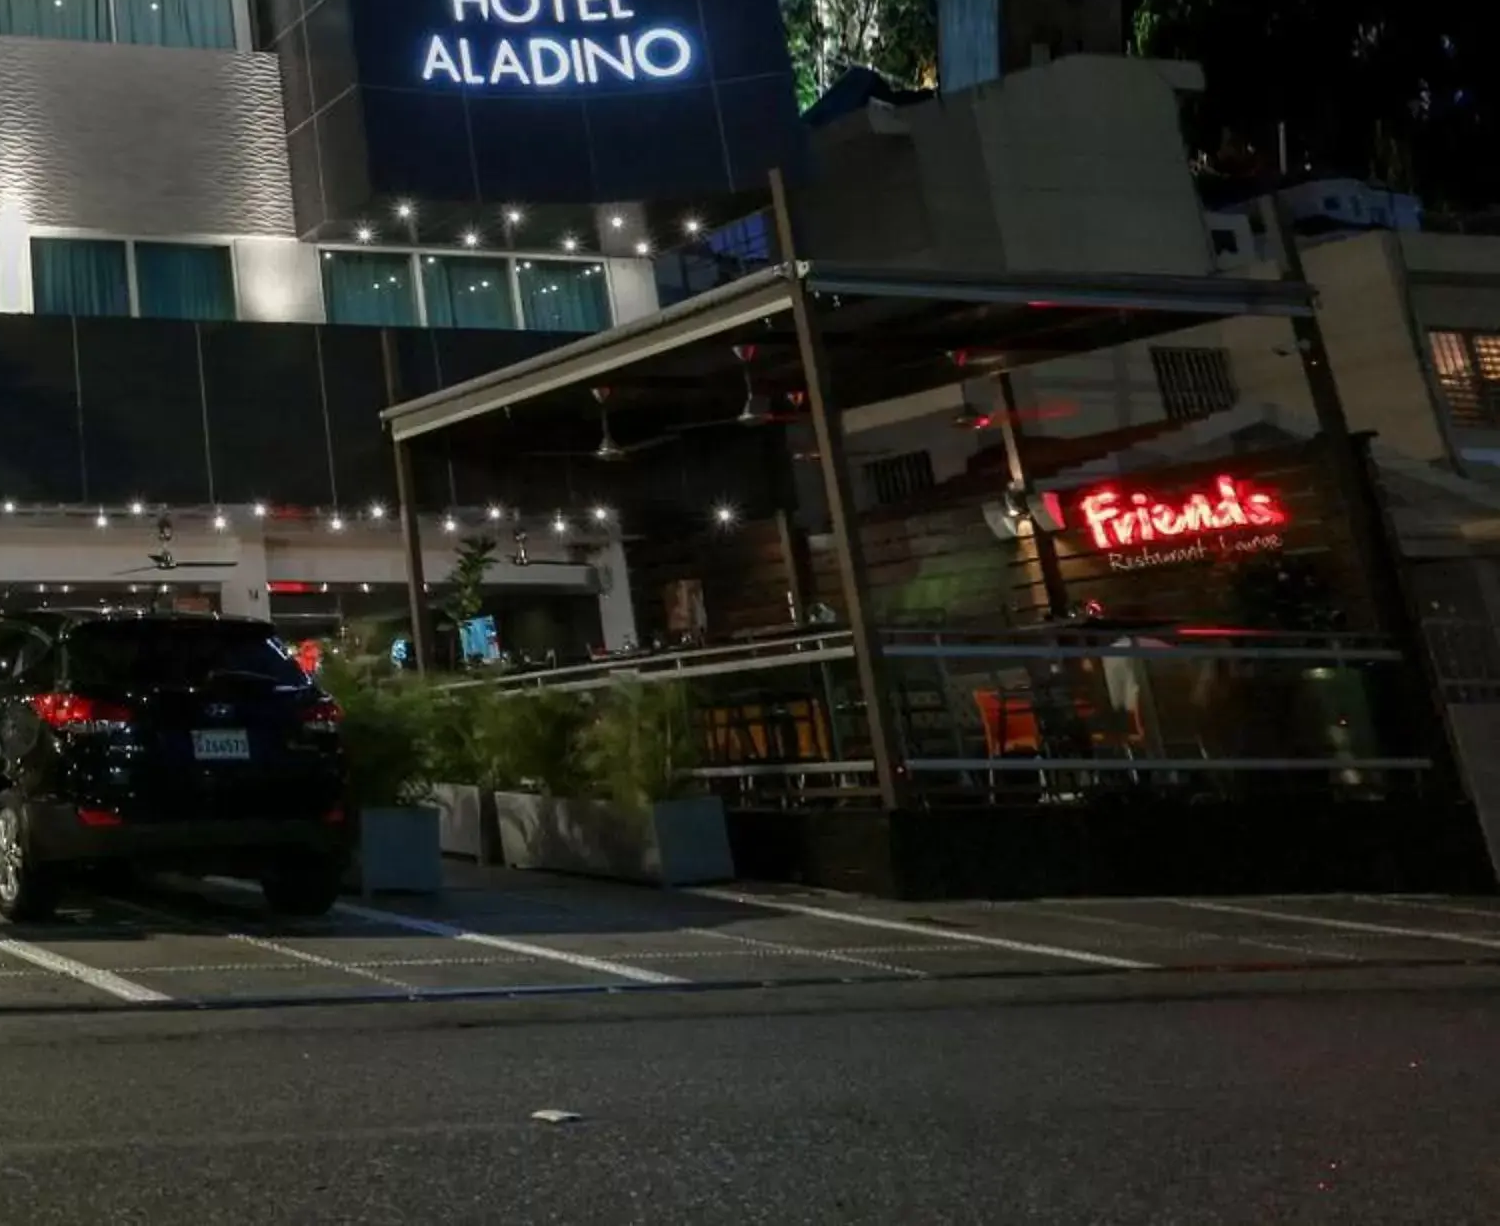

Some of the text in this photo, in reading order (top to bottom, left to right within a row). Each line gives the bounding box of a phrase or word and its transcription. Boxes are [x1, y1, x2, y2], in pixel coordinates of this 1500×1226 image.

[421, 27, 692, 87] ALADINO
[1080, 473, 1286, 549] Friends
[1108, 538, 1208, 571] Restaurant
